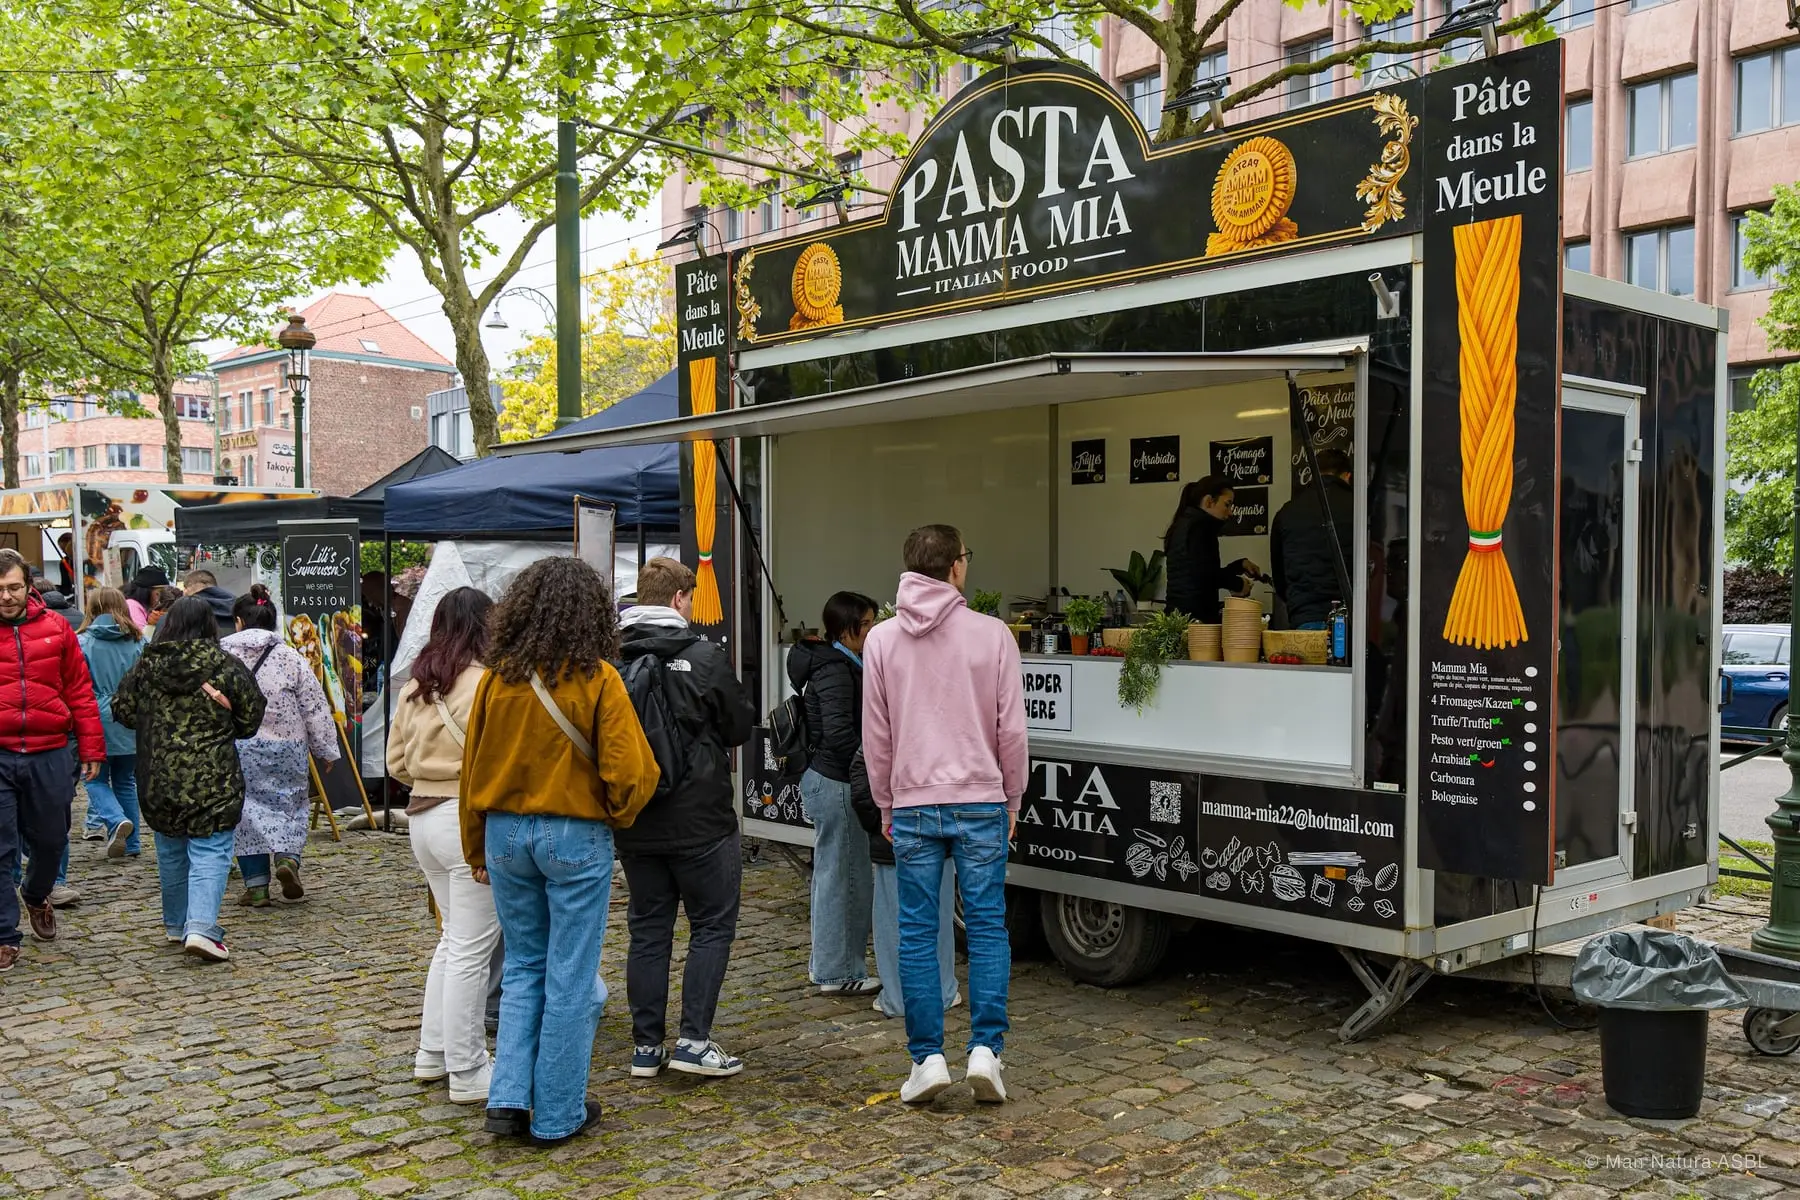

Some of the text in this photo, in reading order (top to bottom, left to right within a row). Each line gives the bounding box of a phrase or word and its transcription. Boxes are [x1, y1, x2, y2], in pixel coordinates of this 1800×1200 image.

[1453, 76, 1531, 122] Pâte
[1446, 122, 1536, 162] dans la
[898, 105, 1136, 232] PASTA
[1436, 160, 1547, 213] Meule
[896, 191, 1132, 280] MAMMA MIA
[686, 270, 718, 297] Pâte
[934, 256, 1068, 294] ITALIAN FOOD
[686, 300, 720, 321] dans la
[682, 324, 725, 352] Meule
[1334, 388, 1355, 404] dan
[1318, 403, 1355, 428] Meul
[1134, 450, 1176, 471] Arrabiata
[1216, 446, 1266, 465] 4 Fromages
[1231, 504, 1265, 524] lognaise
[307, 544, 337, 565] Lili's
[294, 597, 346, 606] PASSION
[1431, 661, 1488, 675] Mamma Mia
[1024, 700, 1056, 720] HERE
[1431, 694, 1513, 710] 4 Fromages/Kazen
[1431, 715, 1493, 730] Truffe/Truffel
[1431, 734, 1502, 751] Pesto vert/groen
[1431, 752, 1471, 766] Arrabiata
[1431, 771, 1475, 786] Carbonara
[1432, 790, 1478, 805] Bolognaise
[1053, 808, 1119, 837] MIA
[1202, 800, 1394, 838] mamma-mia22@hotmail.com
[1028, 844, 1077, 862] FOOD
